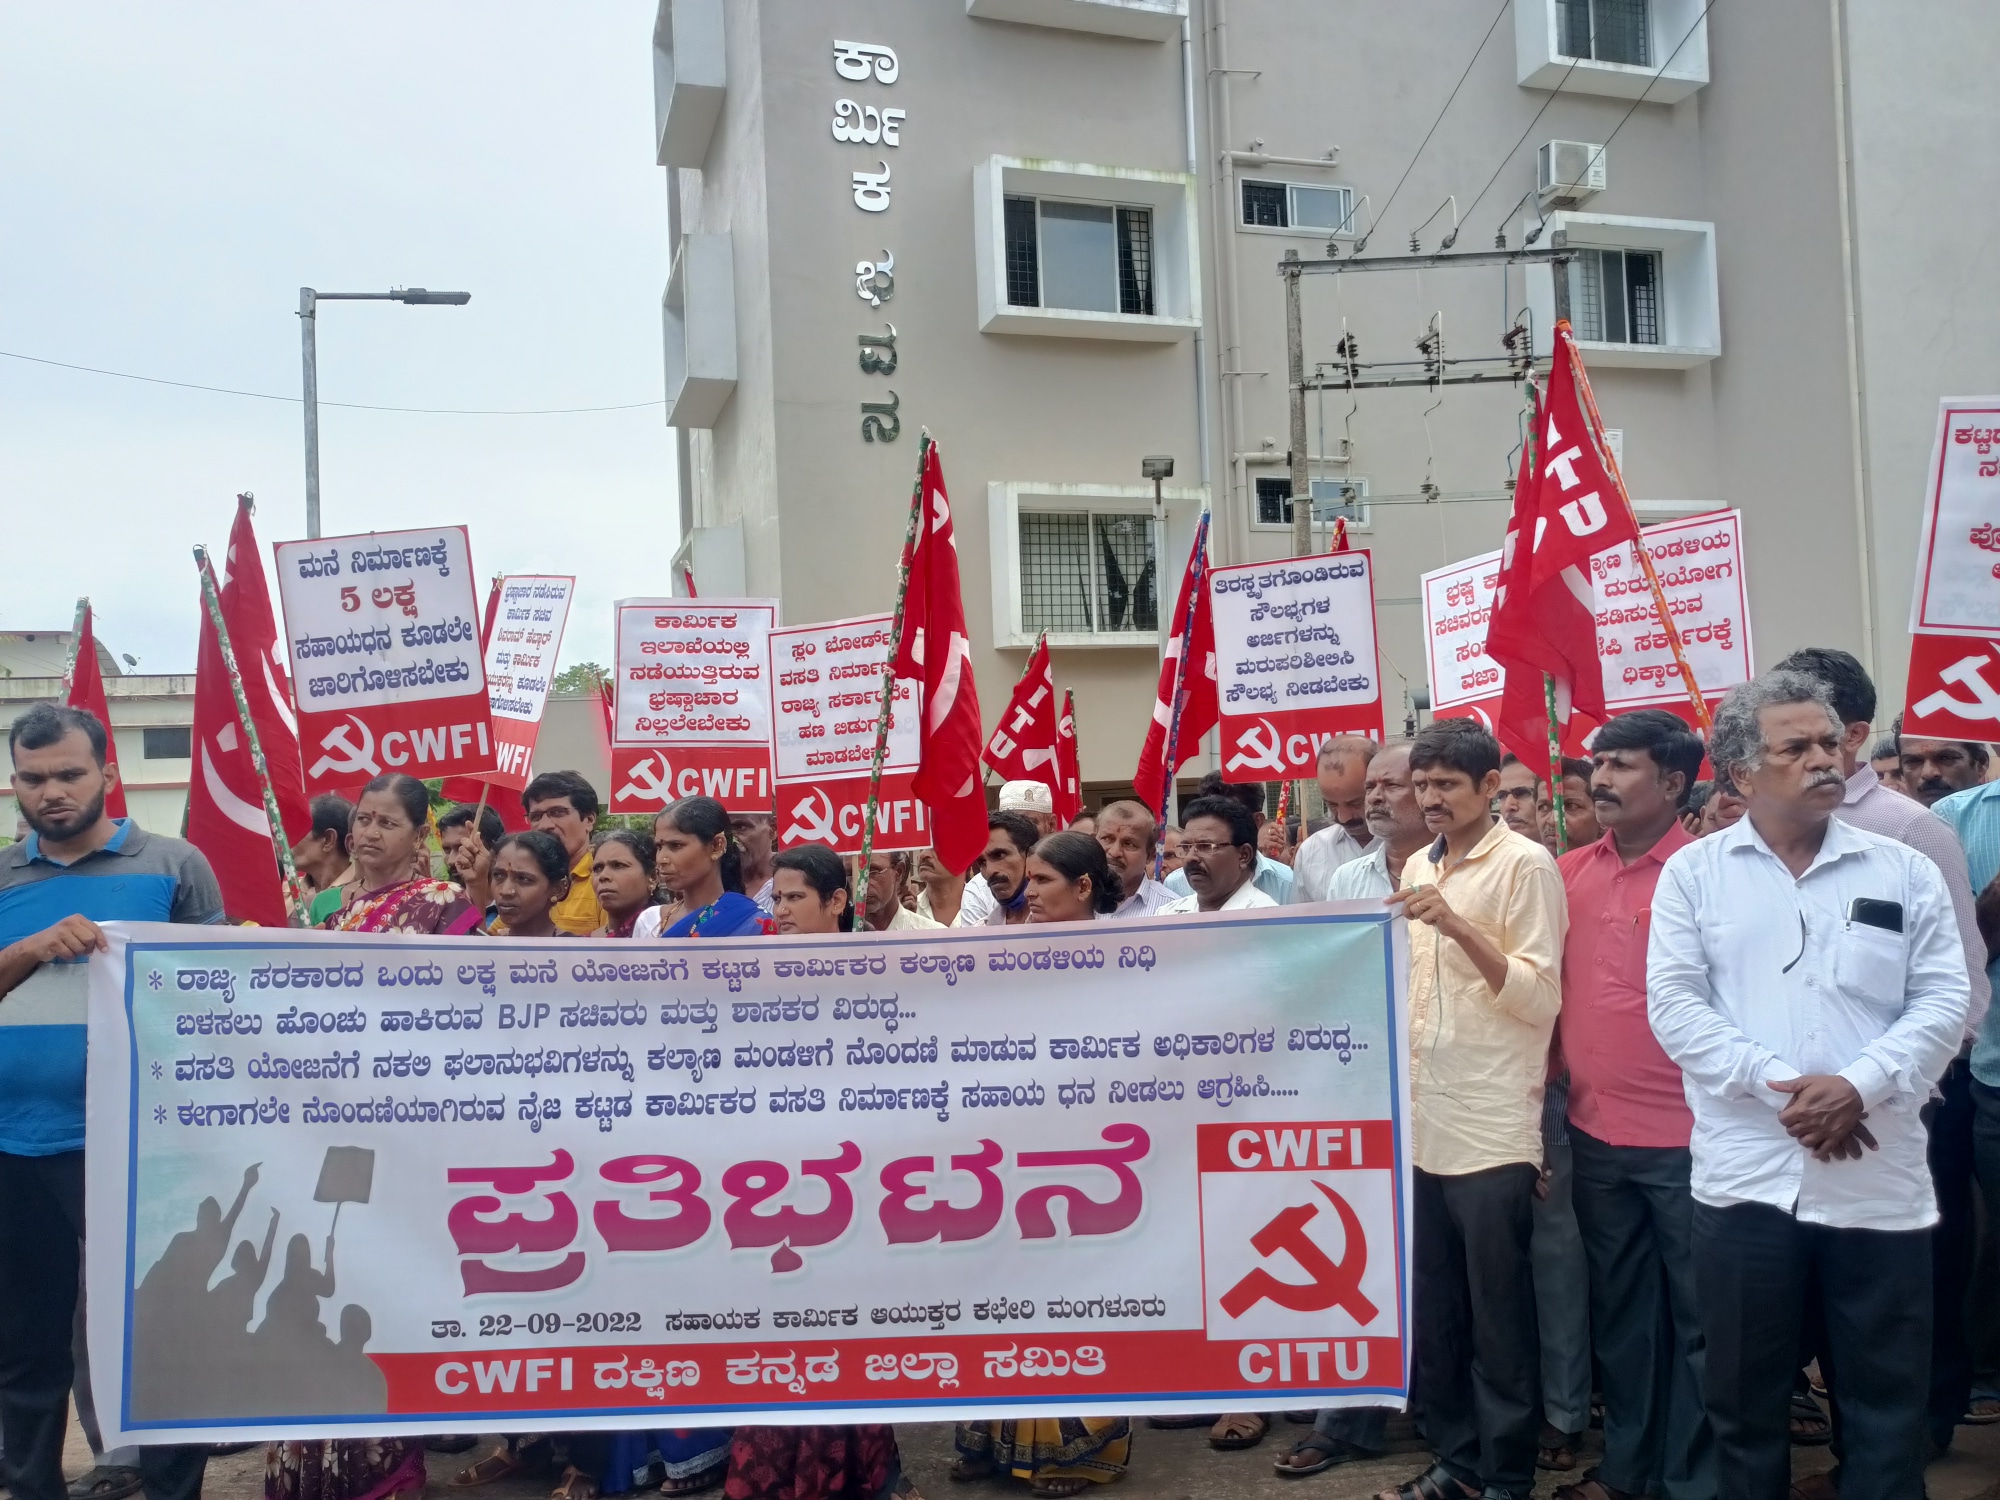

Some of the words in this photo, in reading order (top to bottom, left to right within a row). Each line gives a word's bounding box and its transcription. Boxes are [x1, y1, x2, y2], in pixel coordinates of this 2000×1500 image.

[832, 39, 905, 212] ಕಾರ್ಮಿಕ
[855, 248, 900, 443] ಭವನ
[298, 549, 341, 579] ಮನೆ
[351, 538, 450, 577] ನಿರ್ಮಾಣಕ್ಕೆ
[341, 586, 361, 612] 5
[371, 577, 418, 619] ಲಕ್ಷ
[1250, 596, 1331, 623] ಸೌಲಭ್ಯಗಳ
[295, 623, 392, 660] ಸಹಾಯಧನ
[401, 616, 473, 648] ಕೂಡಲೇ
[654, 612, 738, 629] ಕಾರ್ಮಿಕ
[640, 637, 750, 660] ಇಲಾಖೆಯಲ್ಲಿ
[308, 655, 469, 697] ಜಾರಿಗೊಳಿಸಬೇಕು
[629, 662, 760, 684] ನಡೆಯುತ್ತಿರುವ
[780, 668, 820, 687] ವಸತಿ
[1226, 681, 1278, 705] ಸೌಲಭ್ಯ
[1286, 672, 1370, 697] ನೀಡಬೇಕು
[648, 689, 739, 712] ಭ್ರಷ್ಟಾಚಾರ
[781, 697, 821, 718] ರಾಜ್ಯ
[381, 721, 489, 766] CWFI
[799, 721, 825, 739] ಹಣ
[495, 740, 531, 777] WFI
[676, 767, 768, 799] CWFI
[839, 798, 925, 837] CWFI
[176, 967, 237, 1004] ರಾಜ್ಯ
[250, 960, 364, 990] ಸರಕಾರದ
[377, 959, 443, 988] ಒಂದು
[457, 959, 497, 997] ಲಕ್ಷ
[509, 958, 558, 984] ಮನೆ
[571, 958, 690, 982] ಯೋಜನೆಗೆ
[702, 957, 761, 992] ಕಟ್ಟಡ
[773, 953, 887, 978] ಕಾರ್ಮಿಕರ
[900, 951, 976, 986] ಕಲ್ಯಾಣ
[988, 943, 1105, 972] ಮಂಡಳಿಯ
[1118, 945, 1157, 972] ನಿಧಿ
[176, 1007, 263, 1036] ಬಳಸಲು
[276, 1004, 367, 1035] ಹೊಂಚು
[380, 1002, 483, 1032] ಹಾಕಿರುವ
[498, 1003, 551, 1029] BJP
[559, 999, 648, 1028] ಸಚಿವರು
[660, 996, 719, 1034] ಮತ್ತು
[731, 994, 820, 1022] ಶಾಸಕರ
[175, 1052, 235, 1082] ವಸತಿ
[247, 1050, 361, 1080] ಯೋಜನೆಗೆ
[372, 1048, 432, 1078] ನಕಲಿ
[443, 1043, 635, 1082] ಫಲಾನುಭವಿಗಳನ್ನು
[646, 1042, 722, 1083] ಕಲ್ಯಾಣ
[734, 1037, 834, 1068] ಮಂಡಳಿಗೆ
[846, 1035, 939, 1065] ನೊಂದಣಿ
[950, 1032, 1037, 1063] ಮಾಡುವ
[1049, 1029, 1141, 1060] ಕಾರ್ಮಿಕ
[1153, 1025, 1276, 1061] ಅಧಿಕಾರಿಗಳ
[177, 1095, 290, 1127] ಈಗಾಗಲೇ
[302, 1092, 506, 1125] ನೊಂದಣಿಯಾಗಿರುವ
[518, 1091, 562, 1134] ನೈಜ
[575, 1089, 633, 1132] ಕಟ್ಟಡ
[645, 1085, 757, 1117] ಕಾರ್ಮಿಕರ
[769, 1083, 826, 1113] ವಸತಿ
[838, 1080, 950, 1122] ನಿರ್ಮಾಣಕ್ಕೆ
[961, 1078, 1045, 1109] ಸಹಾಯ
[1057, 1076, 1096, 1109] ಧನ
[1108, 1074, 1184, 1103] ನೀಡಲು
[1226, 1127, 1364, 1168] CWFI
[446, 1122, 1152, 1299] ಪ್ರತಿಭಟನೆ
[431, 1316, 467, 1339] ತಾ.
[479, 1311, 642, 1337] 22-09-2022
[665, 1307, 761, 1333] ಸಹಾಯಕ
[772, 1302, 859, 1329] ಕಾರ್ಮಿಕ
[870, 1298, 962, 1330] ಆಯುಕ್ತರ
[973, 1296, 1036, 1323] ಕಛೇರಿ
[1047, 1293, 1167, 1320] ಮಂಗಳೂರು
[434, 1357, 573, 1395] CWFI
[593, 1353, 701, 1400] ದಕ್ಷಿಣ
[725, 1347, 840, 1395] ಕನ್ನಡ
[864, 1351, 960, 1389] ಜಿಲ್ಲಾ
[983, 1341, 1107, 1378] ಸಮಿತಿ
[1237, 1341, 1371, 1383] CITU
